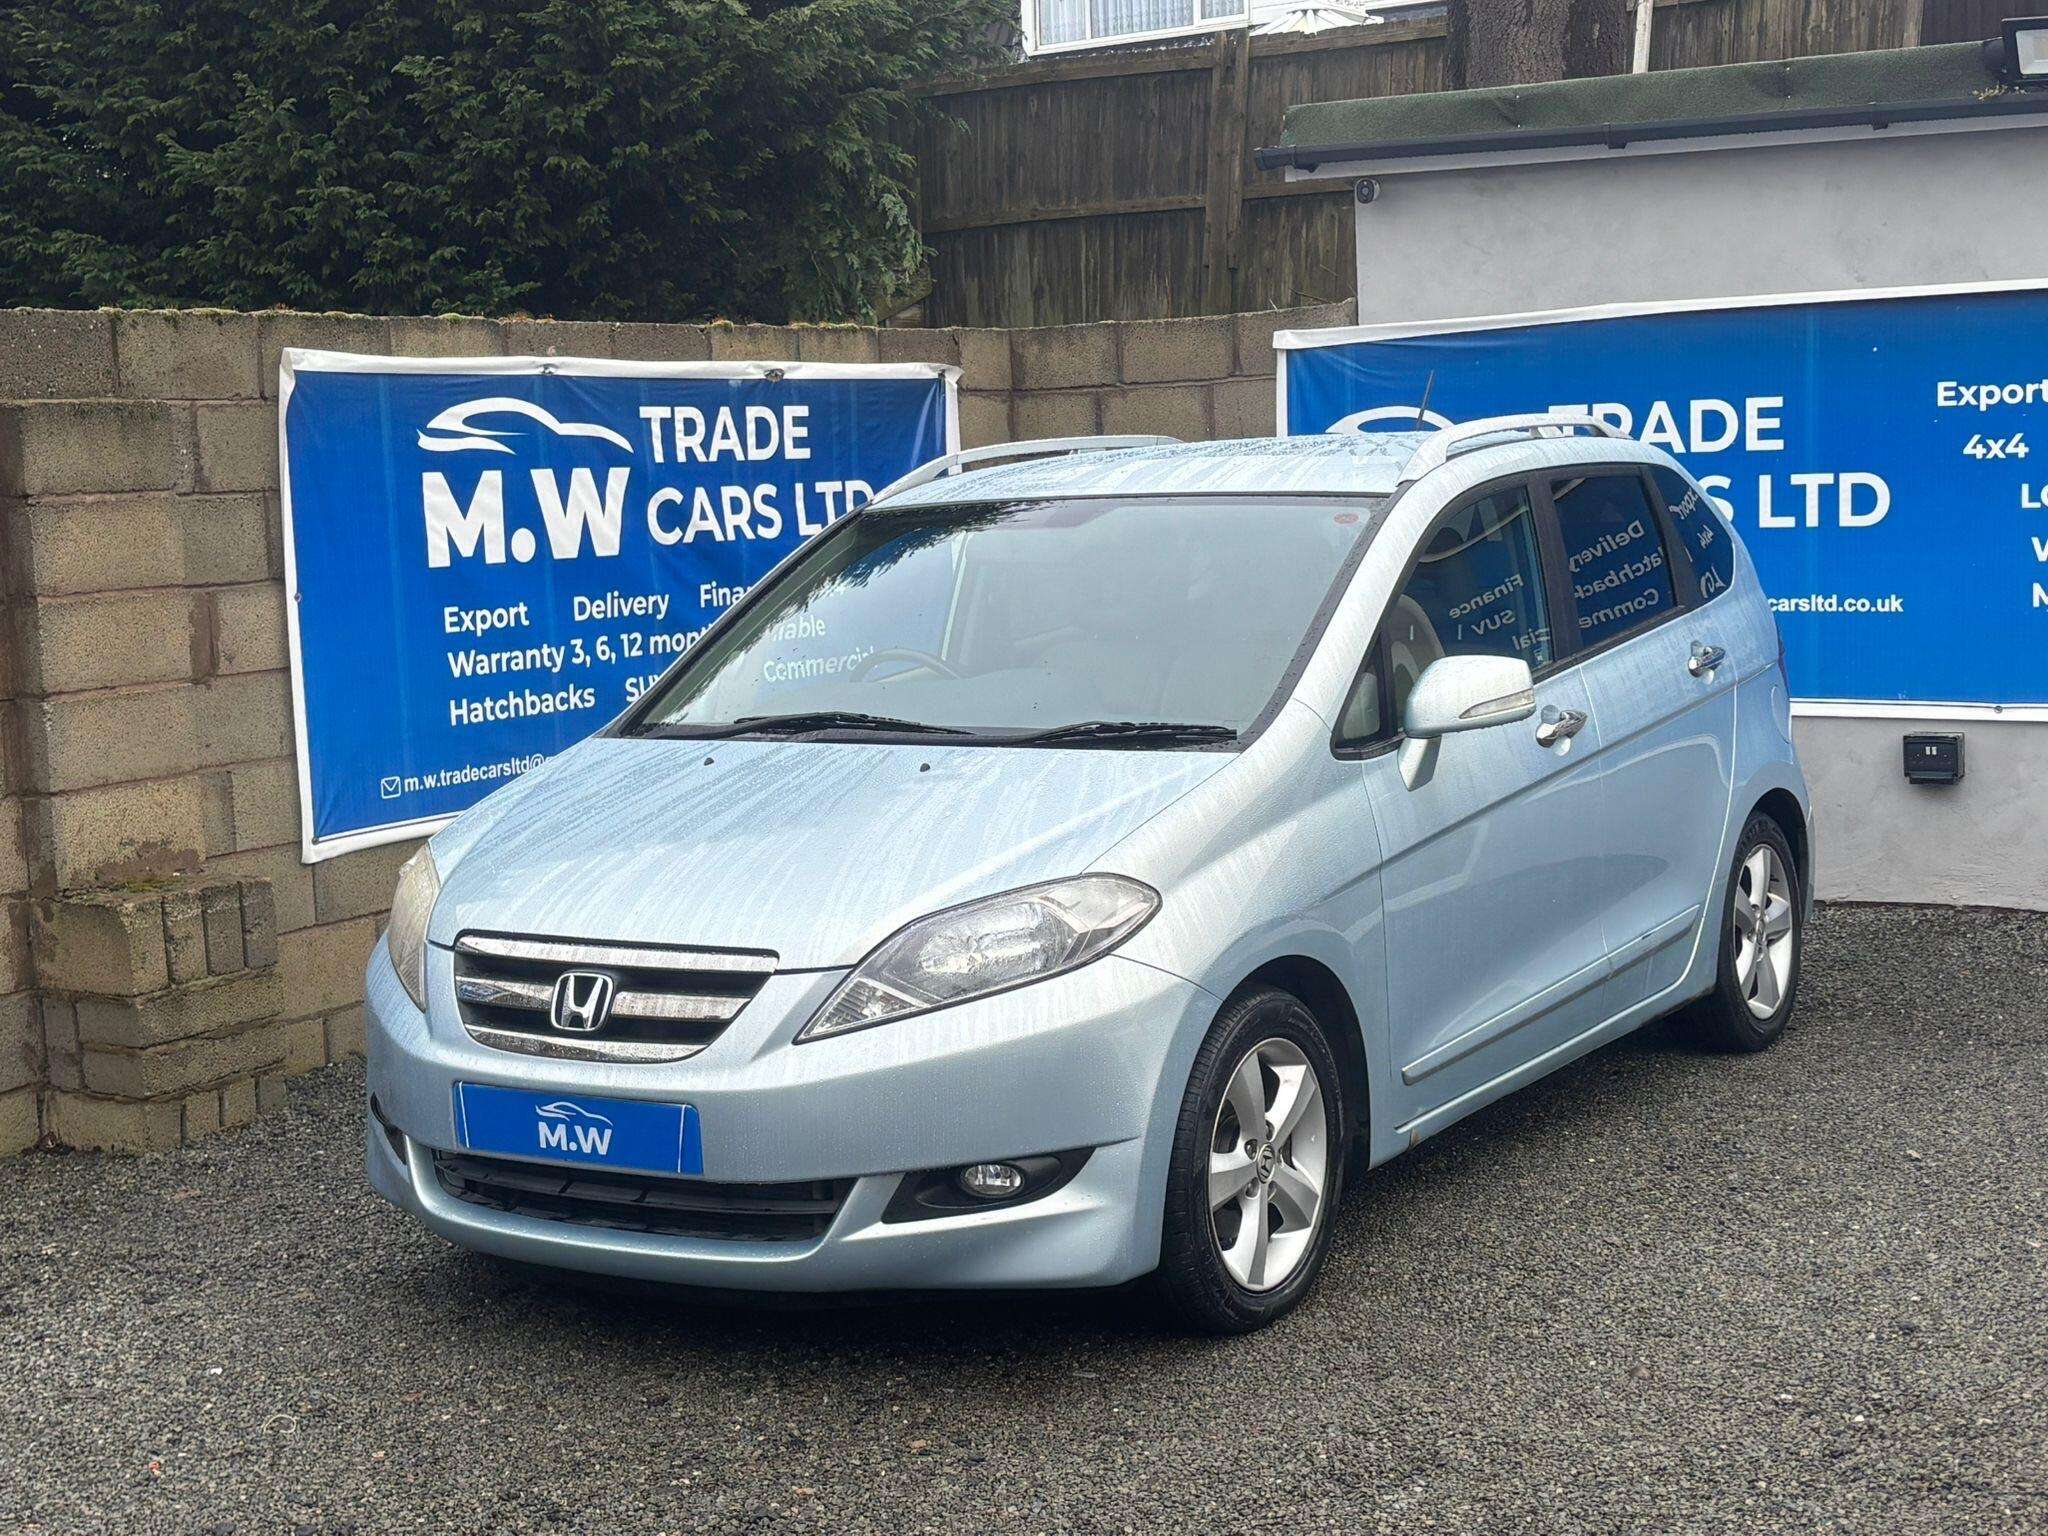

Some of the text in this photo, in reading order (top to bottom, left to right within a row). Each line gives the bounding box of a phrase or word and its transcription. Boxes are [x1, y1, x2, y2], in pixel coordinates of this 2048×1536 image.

[639, 405, 811, 463] TRADE
[1963, 432, 2030, 459] 4x4
[422, 467, 631, 568] M.W
[647, 484, 782, 545] CARS
[1759, 472, 1891, 529] LTD
[443, 581, 752, 637] Export Delivery Fina
[447, 643, 565, 678] Warranty
[570, 638, 591, 667] 3,
[596, 636, 616, 664] 6,
[620, 631, 643, 658] 12
[450, 683, 595, 726] Hatchbacks
[404, 753, 554, 793] m.w.tradecarsltd@
[538, 1121, 612, 1156] M.W
